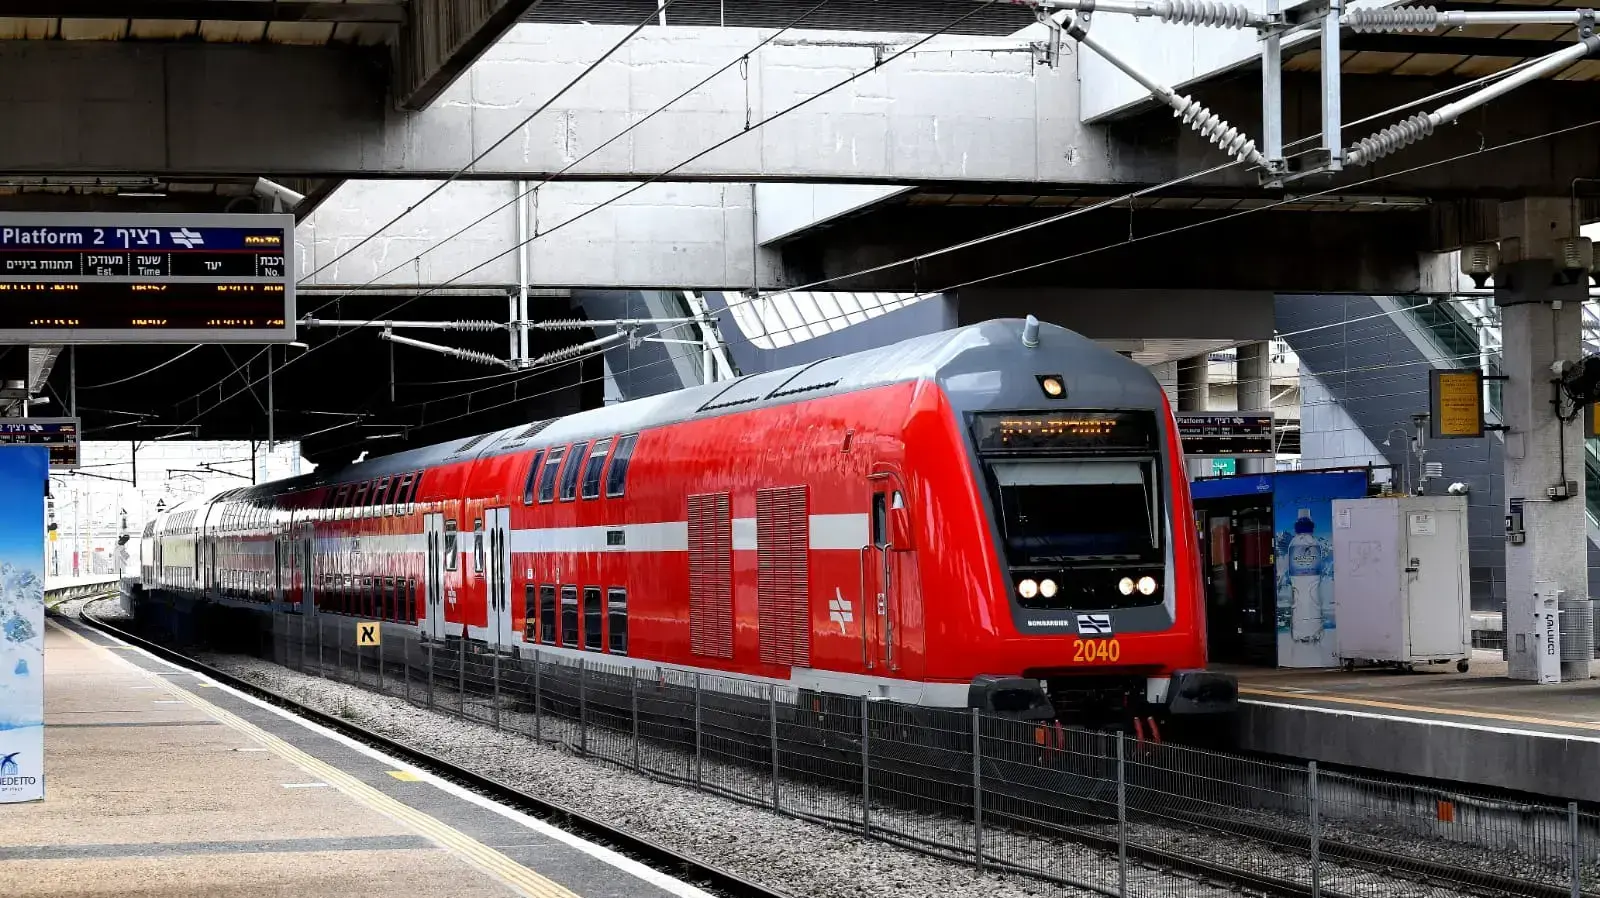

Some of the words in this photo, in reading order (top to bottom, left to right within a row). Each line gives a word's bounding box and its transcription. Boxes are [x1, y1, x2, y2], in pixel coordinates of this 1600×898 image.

[3, 228, 83, 244] Platform
[93, 229, 105, 245] 2
[116, 228, 161, 249] רציף
[6, 260, 37, 270] ביניים
[40, 260, 73, 270] תחנות
[88, 255, 123, 267] מעודכן
[137, 255, 161, 266] שעה
[260, 256, 284, 266] רכבת
[138, 266, 161, 276] Time
[204, 261, 222, 271] יעד
[265, 268, 280, 277] No.
[362, 626, 375, 642] א
[1073, 639, 1120, 662] 2040
